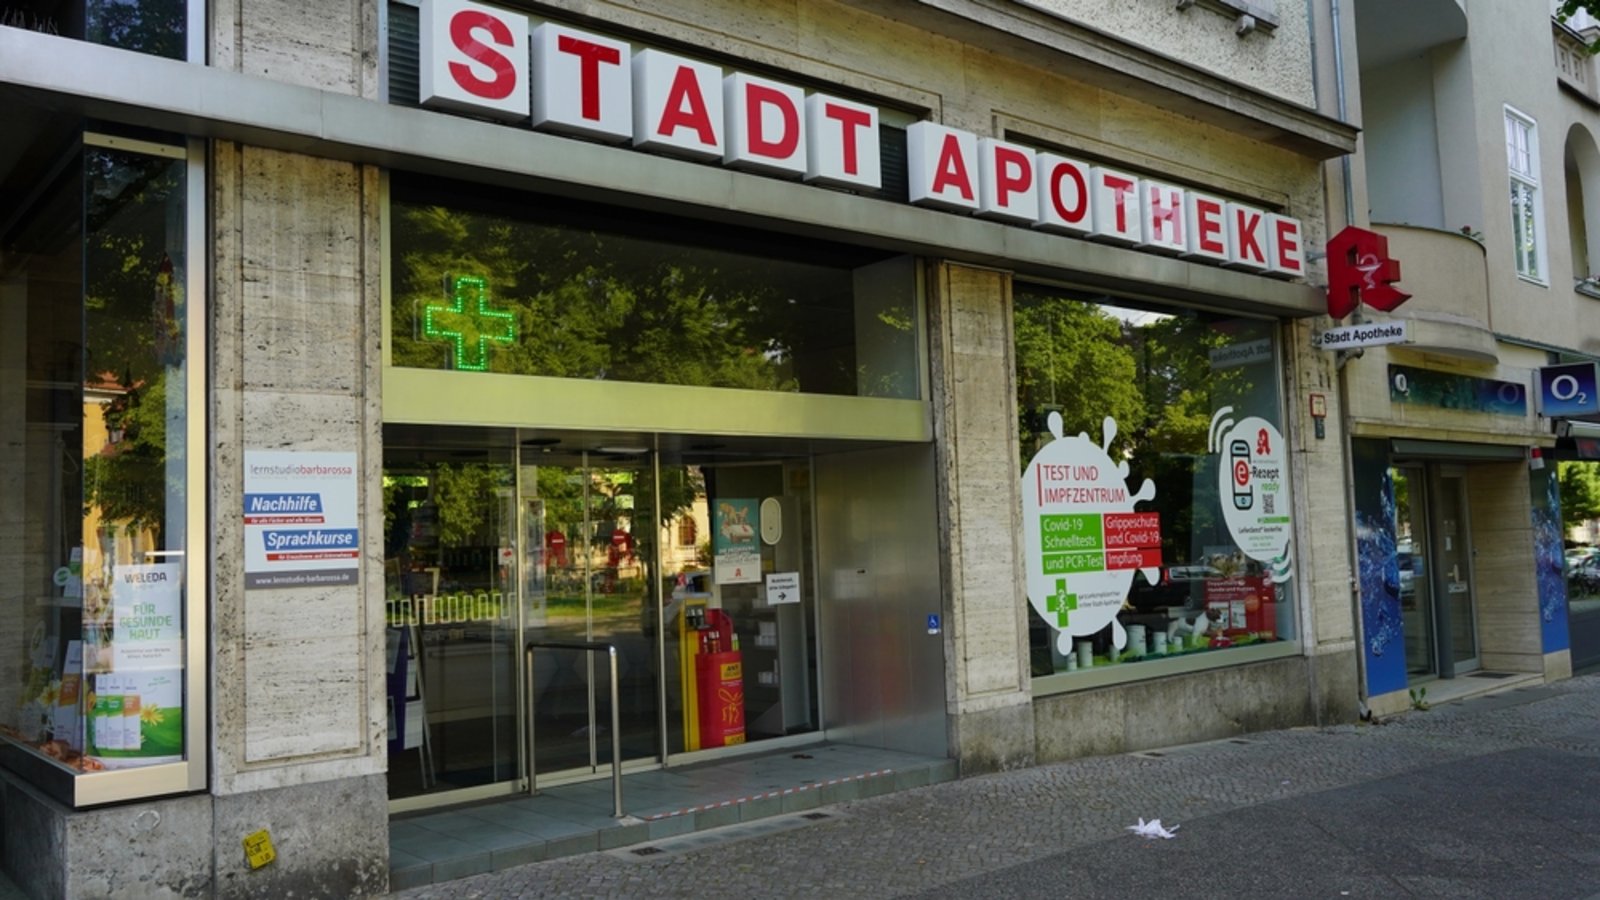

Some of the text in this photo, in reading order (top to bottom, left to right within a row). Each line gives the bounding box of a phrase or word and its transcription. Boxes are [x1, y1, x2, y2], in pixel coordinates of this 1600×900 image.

[447, 9, 1301, 271] STADT APOTHEKE
[1324, 325, 1403, 344] Stadt Apotheke
[250, 464, 353, 476] lernstudiobarbarossa
[1043, 464, 1099, 481] TEST UND
[1044, 487, 1126, 504] IMPFZENTRUM
[250, 496, 317, 512] Nachhilfe
[1043, 517, 1084, 532] Covid-19
[1105, 515, 1159, 531] Grippeschutz
[267, 530, 353, 549] Sprachkurse
[1044, 534, 1097, 548] Schnelltests
[1106, 533, 1124, 545] und
[1046, 555, 1064, 570] und
[1107, 552, 1143, 567] Impfung
[124, 572, 168, 583] WELEDA
[133, 601, 156, 615] FÜR
[119, 615, 173, 628] GESUNDE
[129, 628, 161, 640] HAUT
